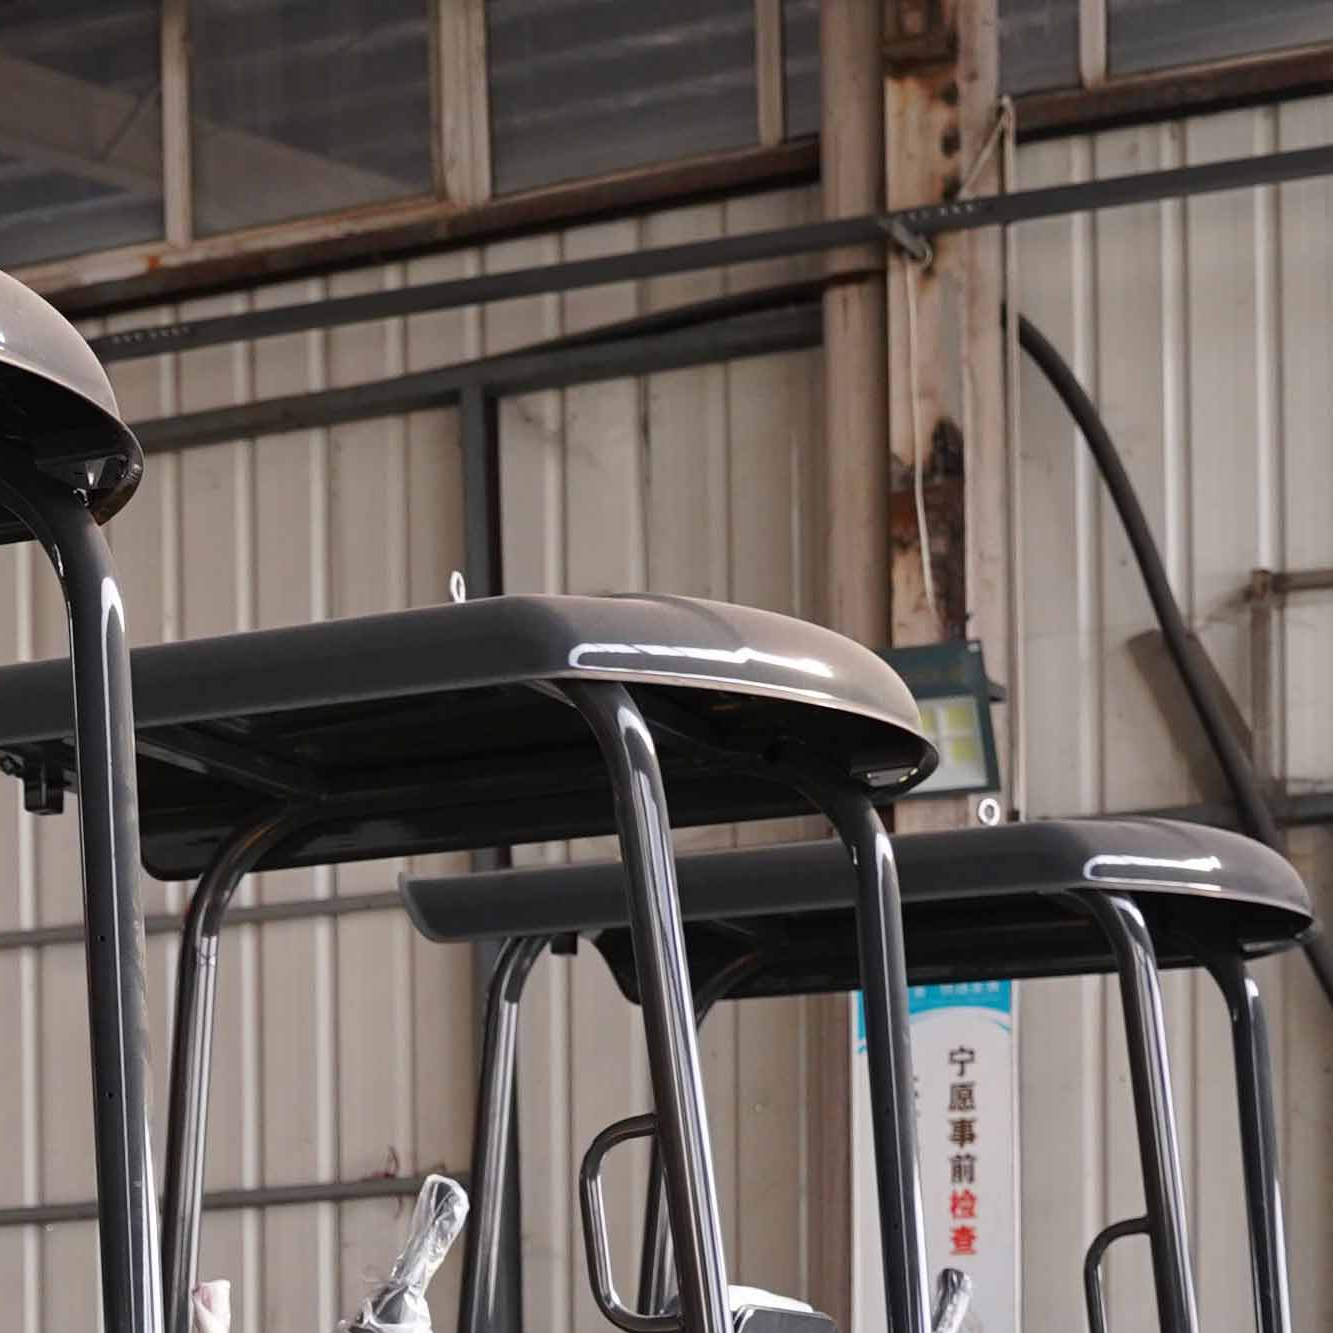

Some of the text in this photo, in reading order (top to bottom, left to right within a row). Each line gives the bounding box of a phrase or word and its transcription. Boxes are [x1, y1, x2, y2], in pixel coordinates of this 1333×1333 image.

[947, 1046, 976, 1255] 宁愿事前检查
